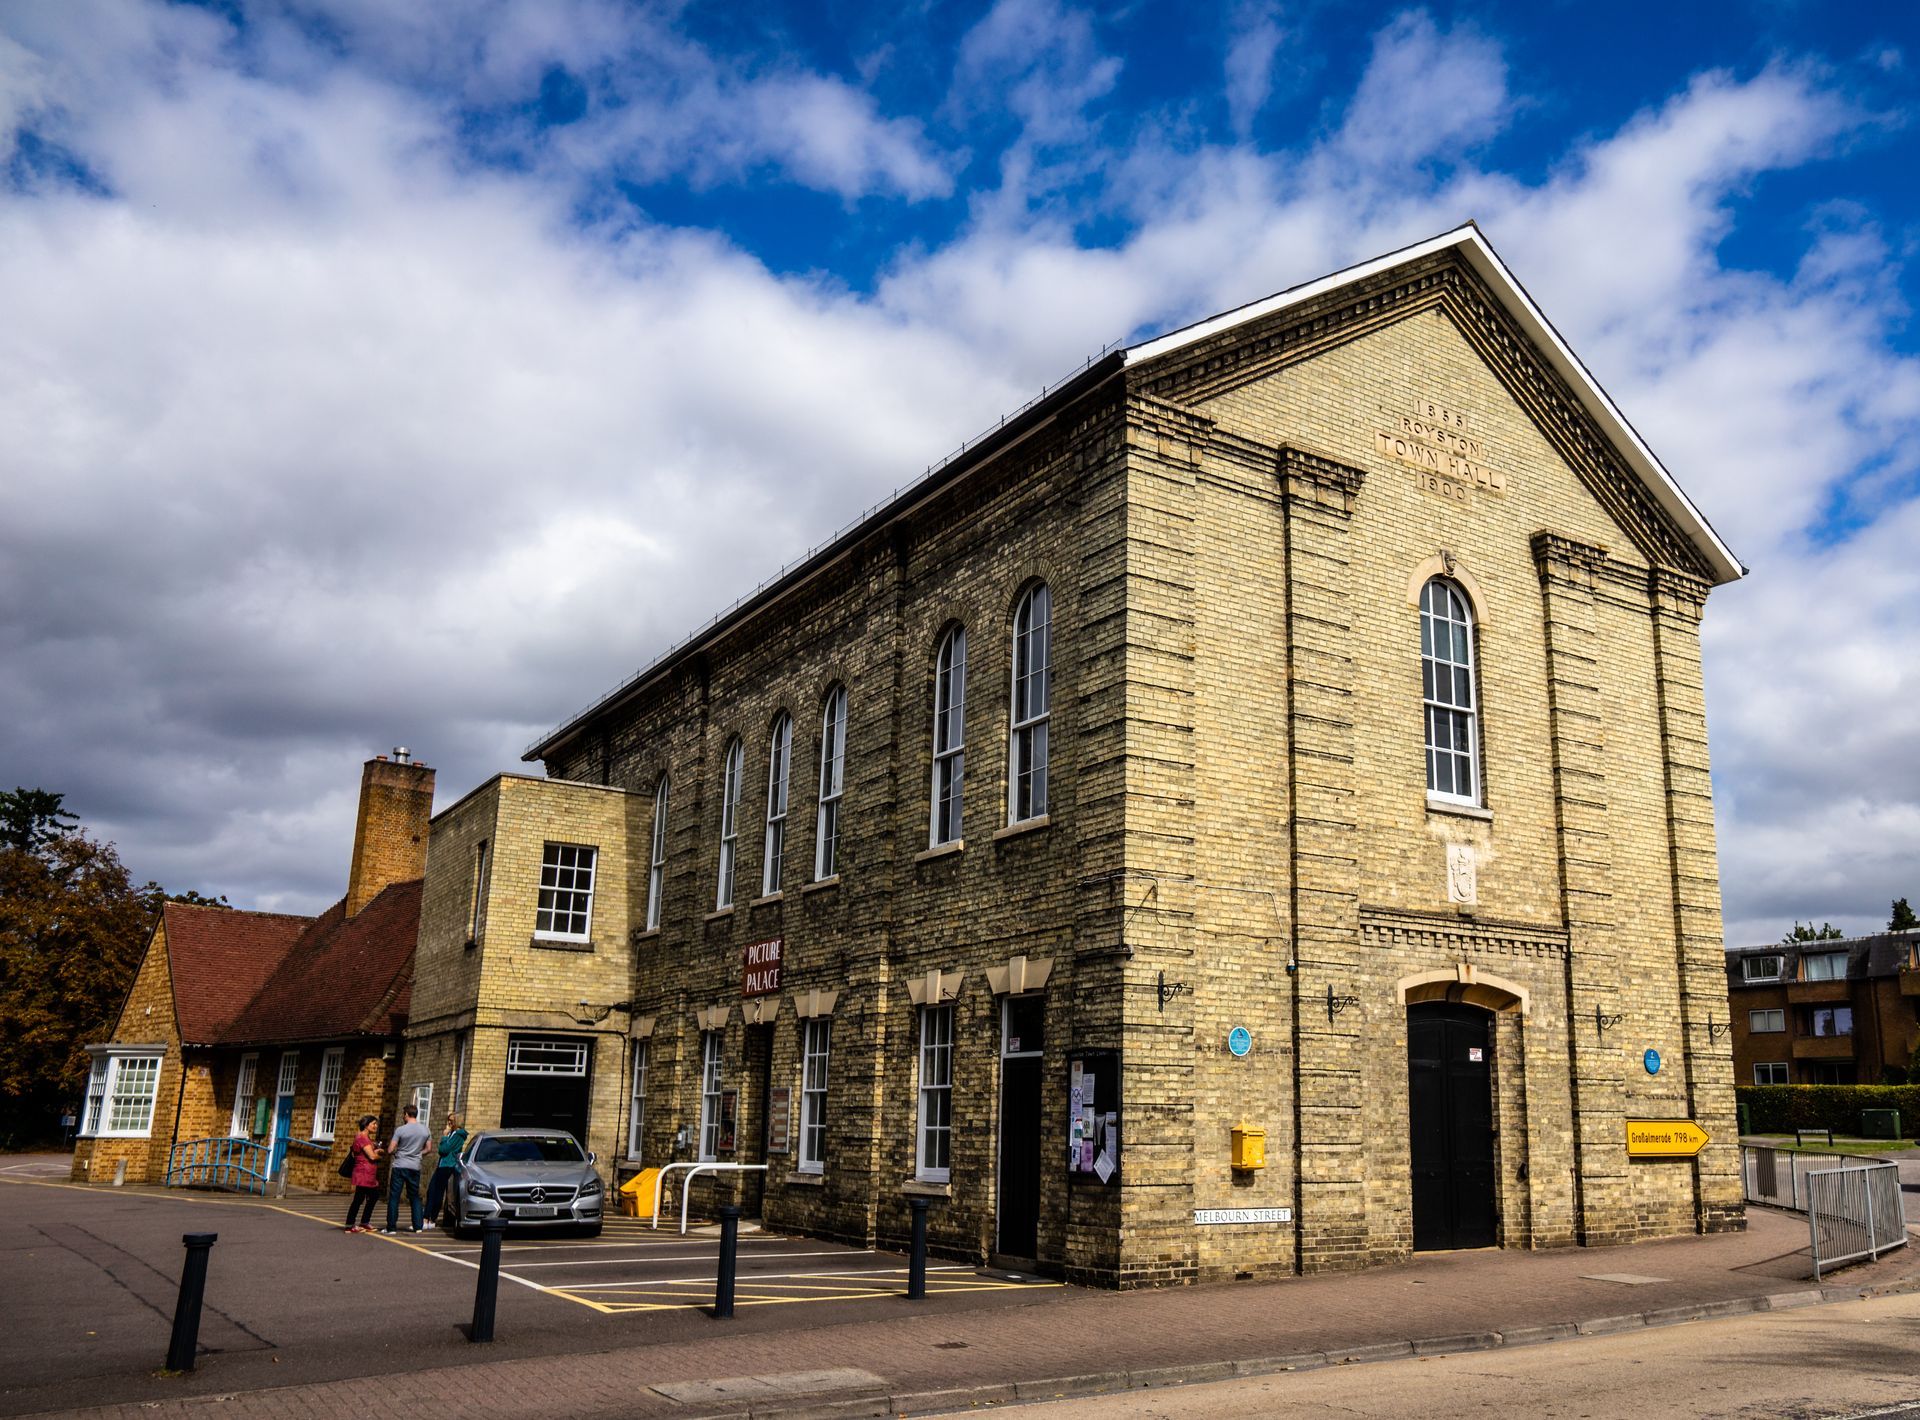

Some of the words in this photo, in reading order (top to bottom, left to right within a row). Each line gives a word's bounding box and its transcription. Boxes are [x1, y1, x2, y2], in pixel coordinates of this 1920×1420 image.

[1416, 400, 1463, 427] 1855
[1403, 417, 1480, 457] ROYSTON
[1378, 433, 1439, 468] TOWN
[1448, 458, 1500, 490] HALL
[748, 940, 782, 966] PICTURE
[746, 968, 780, 993] PALACE
[1631, 1132, 1671, 1143] Großalmerode
[1674, 1132, 1688, 1143] 798
[1689, 1135, 1699, 1143] km
[1194, 1211, 1250, 1223] MELBOURN
[1253, 1209, 1288, 1221] STREET
